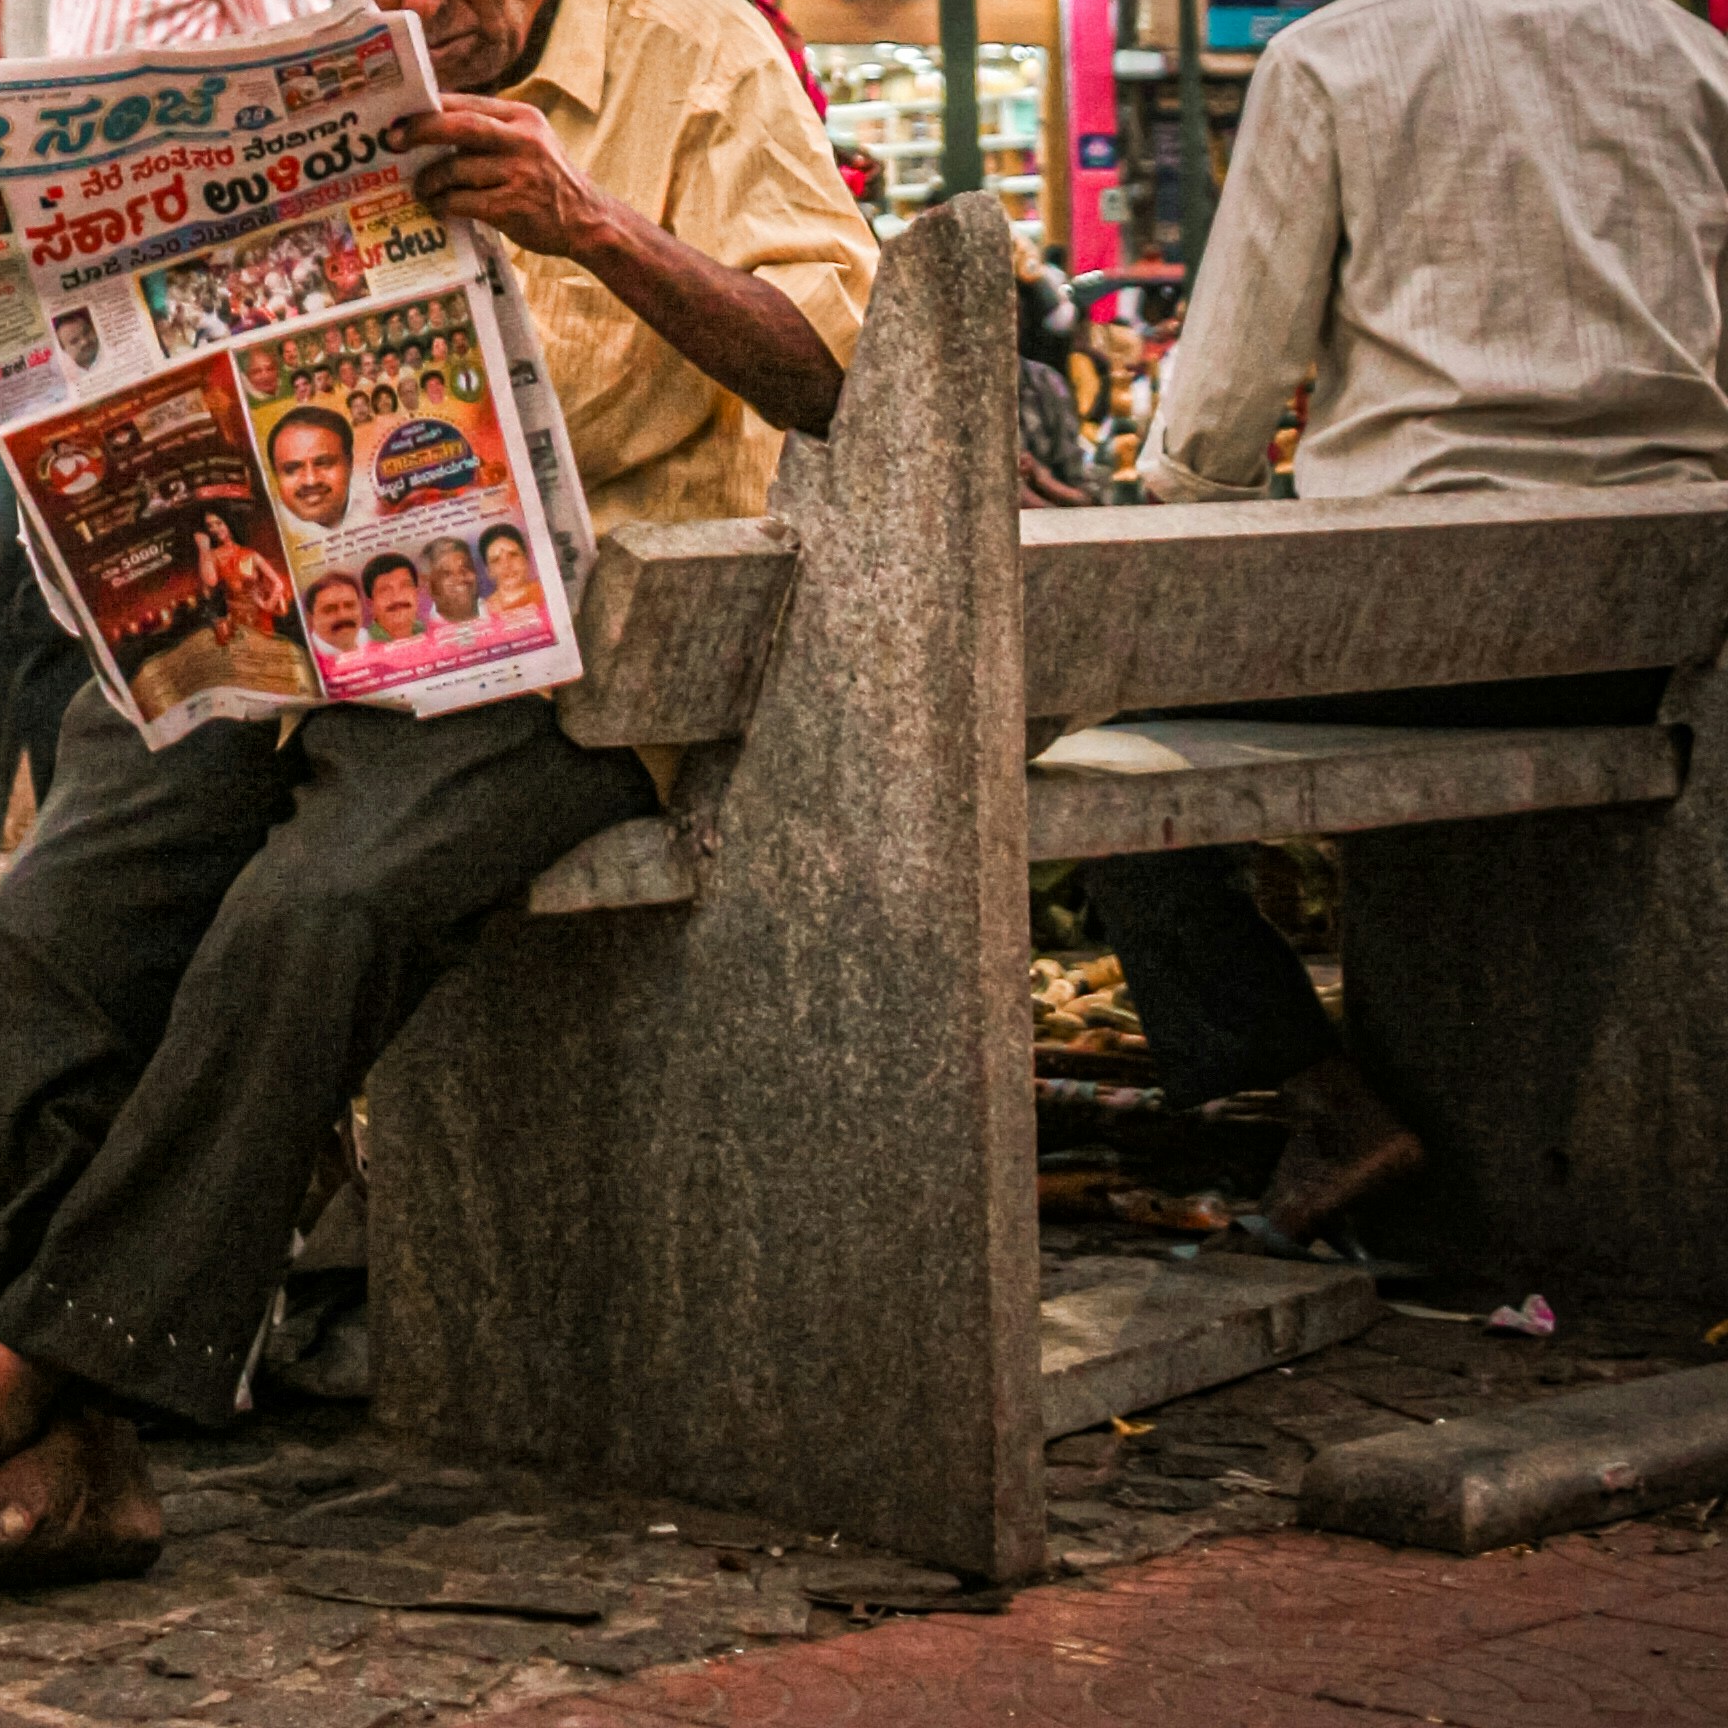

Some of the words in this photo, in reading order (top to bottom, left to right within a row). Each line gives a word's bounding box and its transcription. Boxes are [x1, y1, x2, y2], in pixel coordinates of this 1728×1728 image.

[33, 75, 228, 157] ಸಂಜೆ
[80, 163, 123, 199] ನೆರೆ
[243, 111, 359, 162] ನೆರವಿಗಾಗಿ
[26, 173, 188, 266] ಸರ್ಕಾರ
